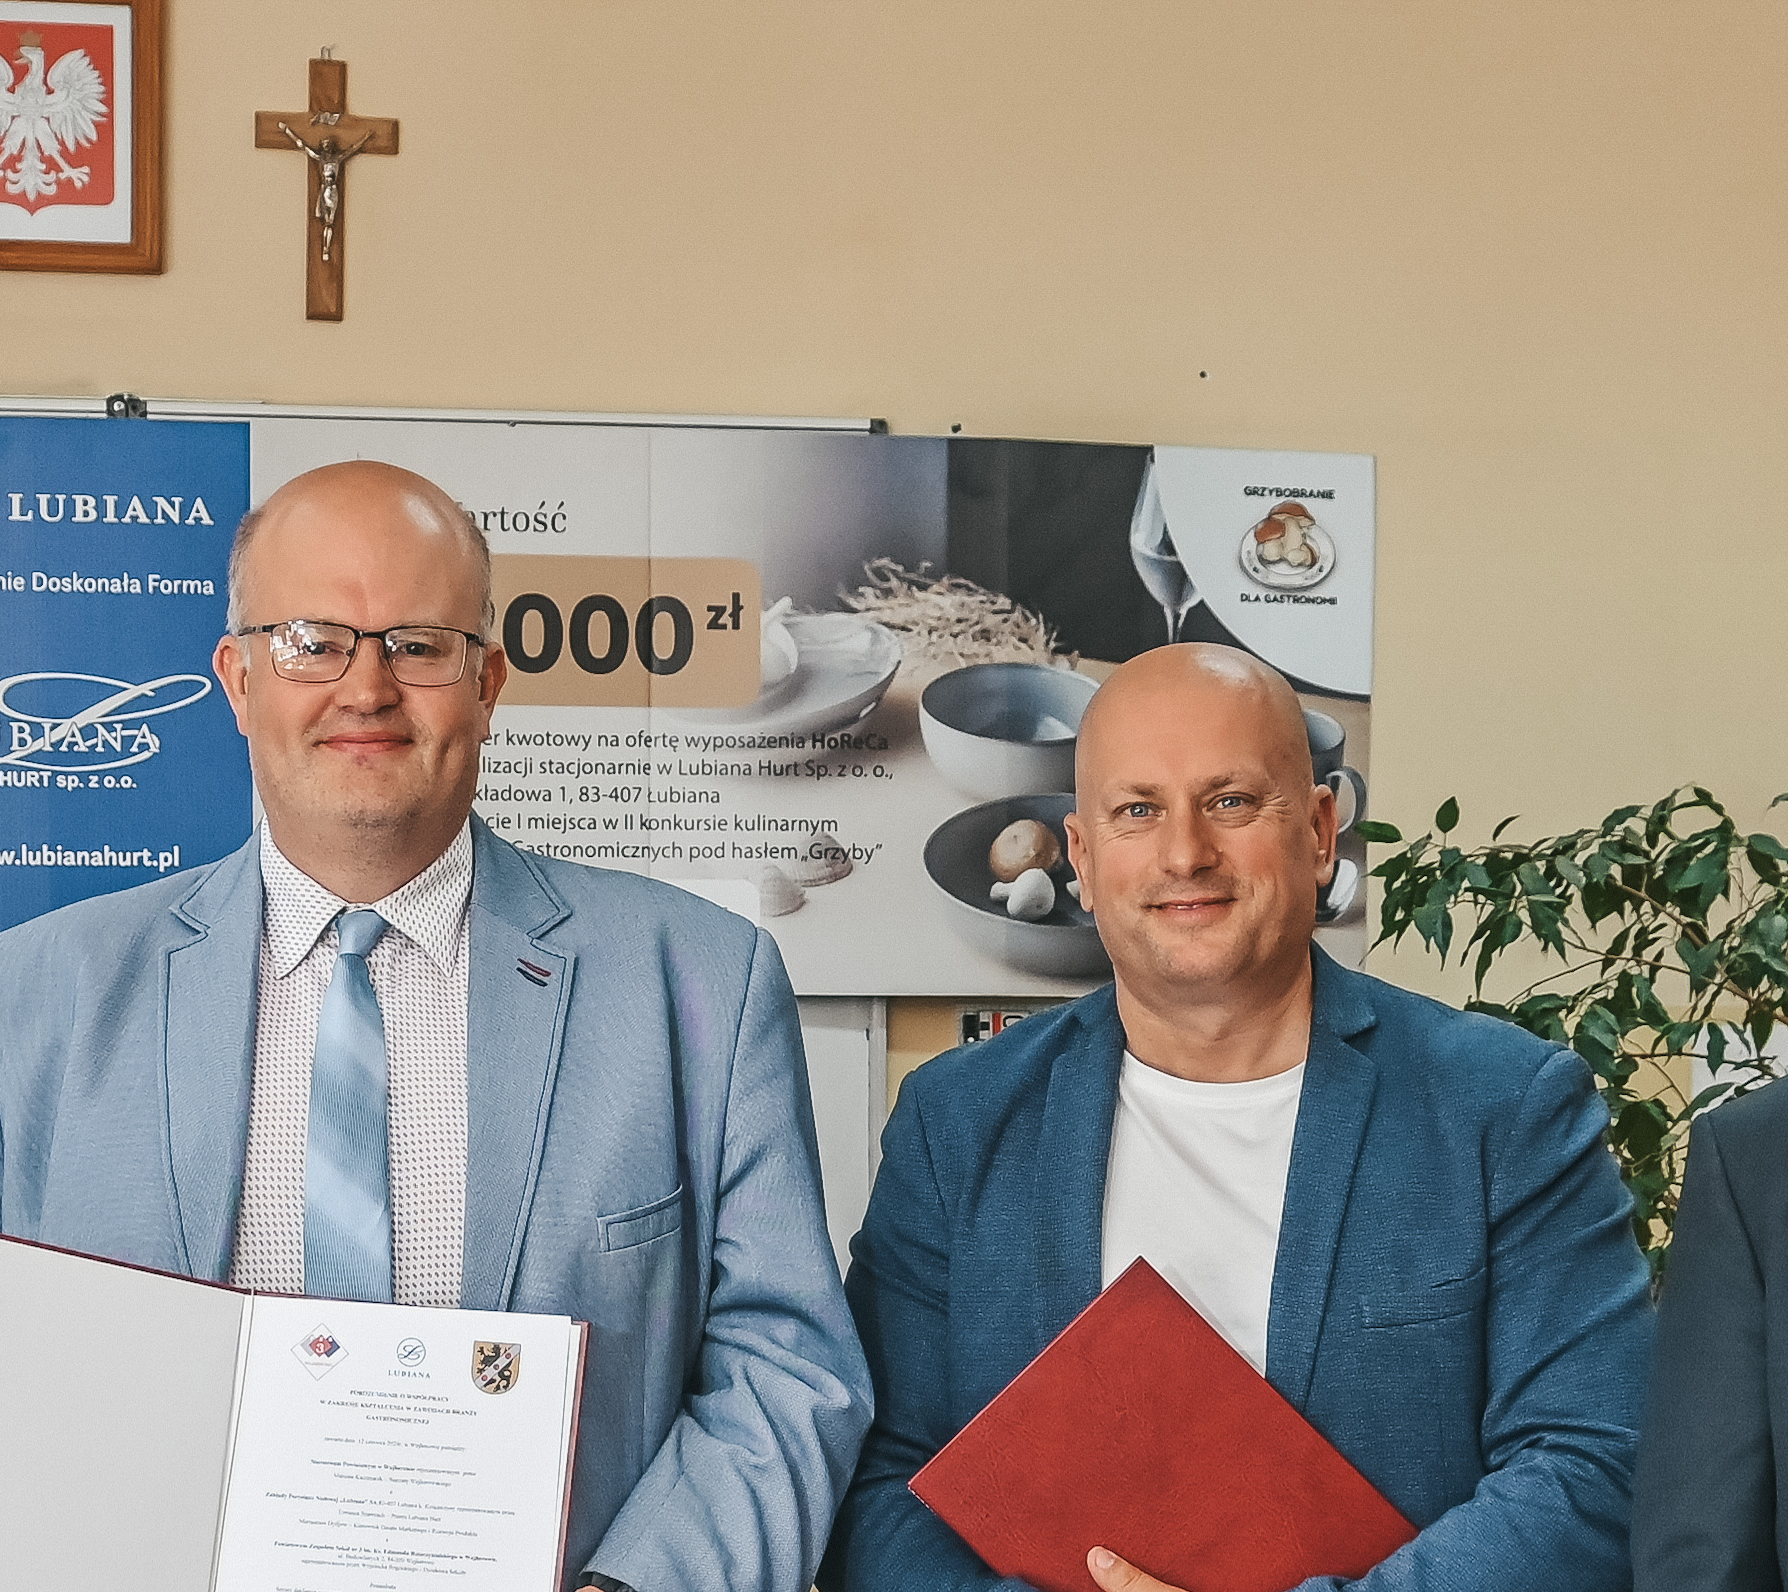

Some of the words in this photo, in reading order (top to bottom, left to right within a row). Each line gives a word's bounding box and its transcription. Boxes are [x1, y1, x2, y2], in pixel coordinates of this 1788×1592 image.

[1243, 485, 1336, 499] GRZYBOBRANIE
[7, 492, 215, 526] LUBIANA
[457, 500, 568, 533] artość
[31, 570, 143, 595] Doskonała
[147, 573, 215, 596] Forma
[1240, 593, 1261, 603] DLA
[706, 591, 744, 630] zł
[506, 728, 592, 751] kwotowy
[597, 734, 619, 748] na
[625, 730, 679, 752] ofertę
[684, 731, 806, 752] wyposażenia
[811, 732, 889, 750] HoReCa
[482, 756, 533, 778] lizacji
[539, 758, 651, 779] stacjonarnie
[656, 763, 672, 776] w
[678, 758, 752, 776] Lubiana
[758, 759, 800, 777] Hurt
[804, 760, 832, 780] Sp.
[837, 765, 847, 777] z
[851, 765, 868, 777] o.
[55, 774, 85, 791] sp.
[88, 776, 100, 789] z
[103, 776, 137, 789] o.o.
[473, 784, 552, 802] kładowa
[559, 786, 573, 804] 1,
[578, 785, 643, 802] 83-407
[527, 814, 597, 834] miejsca
[602, 817, 619, 830] w
[624, 814, 634, 830] II
[639, 813, 728, 831] konkursie
[734, 813, 839, 836] kulinarnym
[689, 841, 725, 862] pod
[731, 841, 798, 859] hasłem
[388, 1369, 432, 1379] LUBIANA
